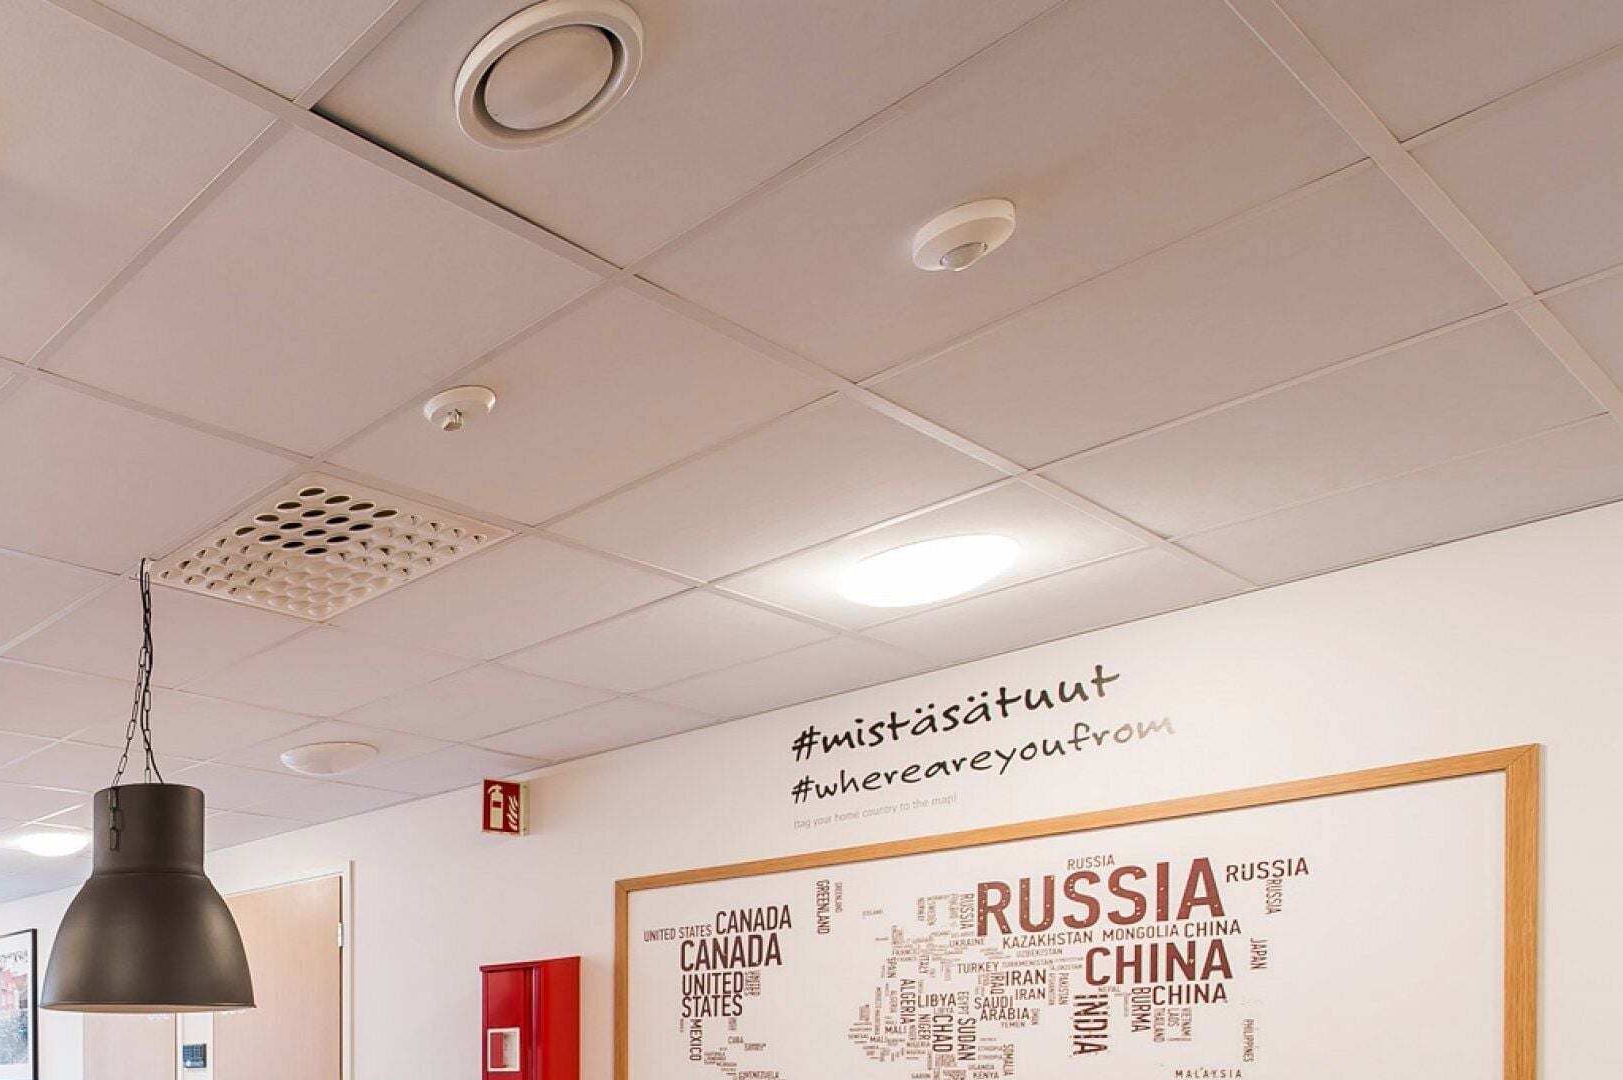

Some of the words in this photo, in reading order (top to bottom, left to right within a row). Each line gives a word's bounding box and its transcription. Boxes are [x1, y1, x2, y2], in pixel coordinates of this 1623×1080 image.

[792, 665, 1119, 761] #mistäsätuut
[792, 717, 1175, 804] #whereareyoufrom
[814, 815, 832, 827] your
[834, 811, 860, 822] home
[862, 804, 897, 818] country
[900, 802, 911, 811] to
[913, 799, 929, 809] the
[1067, 854, 1115, 870] RUSSIA
[1226, 857, 1309, 883] RUSSIA
[816, 879, 830, 935] GREENLAND
[977, 857, 1225, 937] RUSSIA
[1266, 879, 1282, 915] RUSSIA
[716, 905, 792, 935] CANADA
[960, 893, 974, 930] RUSSIA
[644, 927, 676, 942] UNITED
[678, 924, 712, 939] STATES
[949, 938, 984, 948] UKRAINE
[1003, 931, 1093, 949] KAZAKHSTAN
[1103, 924, 1178, 942] MONGOLIA
[1184, 919, 1241, 938] CHINA
[681, 933, 783, 972] CANADA
[1016, 948, 1063, 958] UZBEKISTAN
[1085, 938, 1233, 986] CHINA
[1250, 938, 1267, 971] JAPAN
[958, 961, 999, 974] TURKEY
[1006, 969, 1047, 986] IRAN
[682, 971, 744, 996] UNITED
[990, 972, 1005, 995] IRAQ
[1015, 988, 1046, 1000] IRAN
[1152, 983, 1227, 1005] CHINA
[681, 994, 743, 1018] STATES
[900, 979, 916, 1024] ALGERIA
[918, 993, 956, 1008] LIBYA
[957, 991, 969, 1015] EGYPT
[974, 996, 1013, 1010] SAUDI
[1131, 987, 1151, 1032] BURMA
[918, 1014, 931, 1040] NIGER
[980, 1008, 1030, 1021] ARABIA
[1073, 994, 1108, 1056] INDIA
[1168, 1008, 1179, 1027] LAOS
[689, 1018, 703, 1061] MEXICO
[932, 1015, 953, 1052] CHAD
[957, 1017, 976, 1061] SUDAN
[973, 1072, 999, 1080] KENYA
[1175, 1069, 1242, 1079] MALAYSIA
